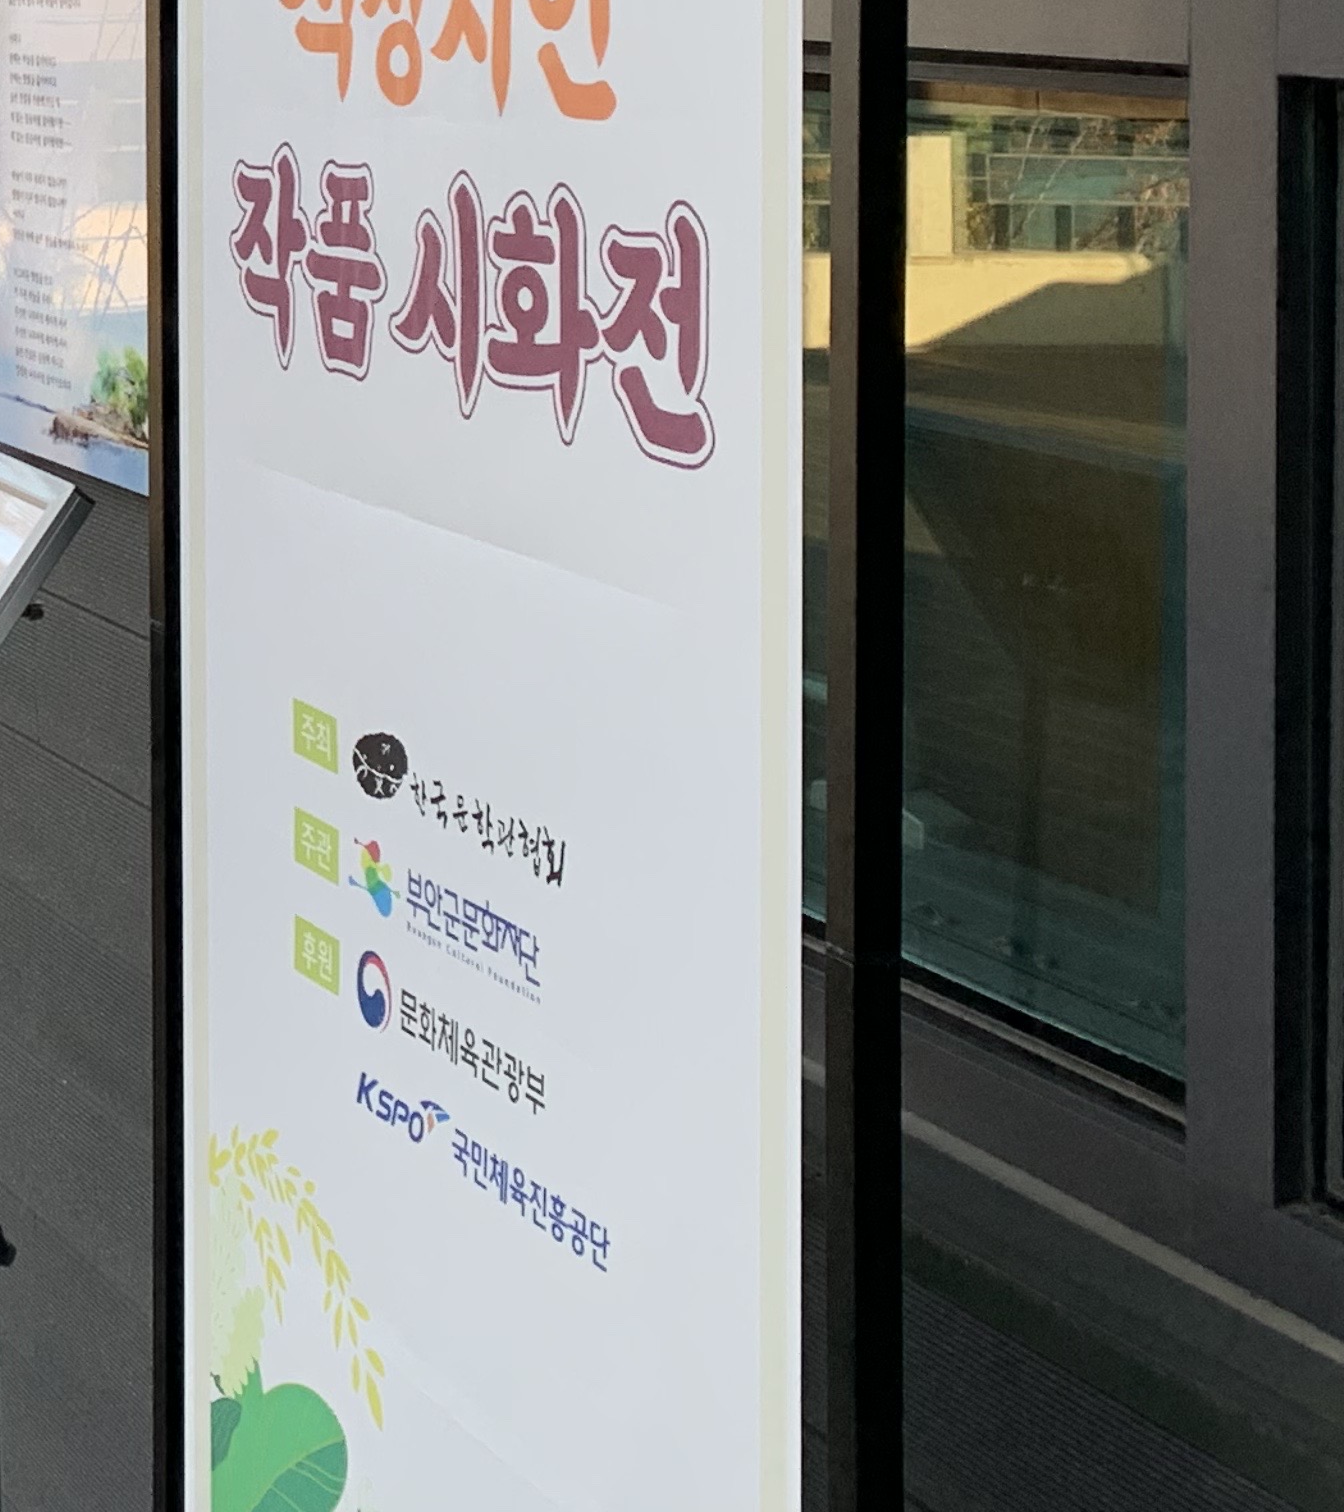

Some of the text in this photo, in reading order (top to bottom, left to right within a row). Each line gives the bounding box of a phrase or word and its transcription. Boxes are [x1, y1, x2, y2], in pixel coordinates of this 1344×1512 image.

[229, 141, 388, 382] 작품
[389, 169, 715, 468] 시화전
[300, 713, 332, 761] 주최
[301, 821, 332, 870] 주관
[410, 772, 568, 887] 한국문학관협회
[302, 932, 332, 982] 후원
[400, 987, 547, 1116] 문화체육관광부
[356, 1071, 611, 1273] KSPO 국민체육진흥공단
